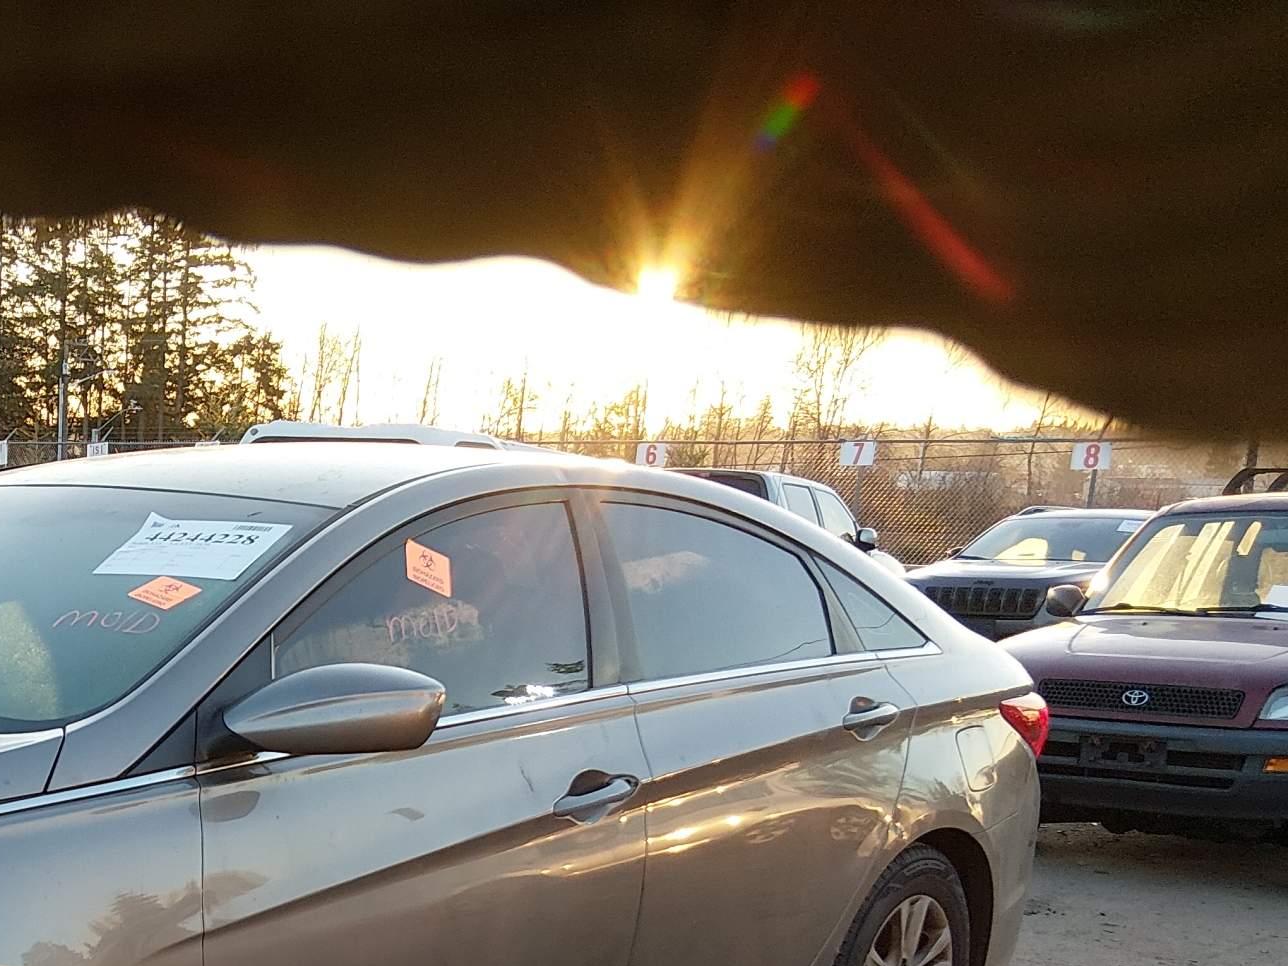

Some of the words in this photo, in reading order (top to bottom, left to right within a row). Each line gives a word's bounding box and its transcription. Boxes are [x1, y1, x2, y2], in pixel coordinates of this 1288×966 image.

[645, 444, 657, 465] 6
[852, 442, 865, 465] 7
[1083, 443, 1101, 469] 8
[144, 531, 260, 545] 44244228
